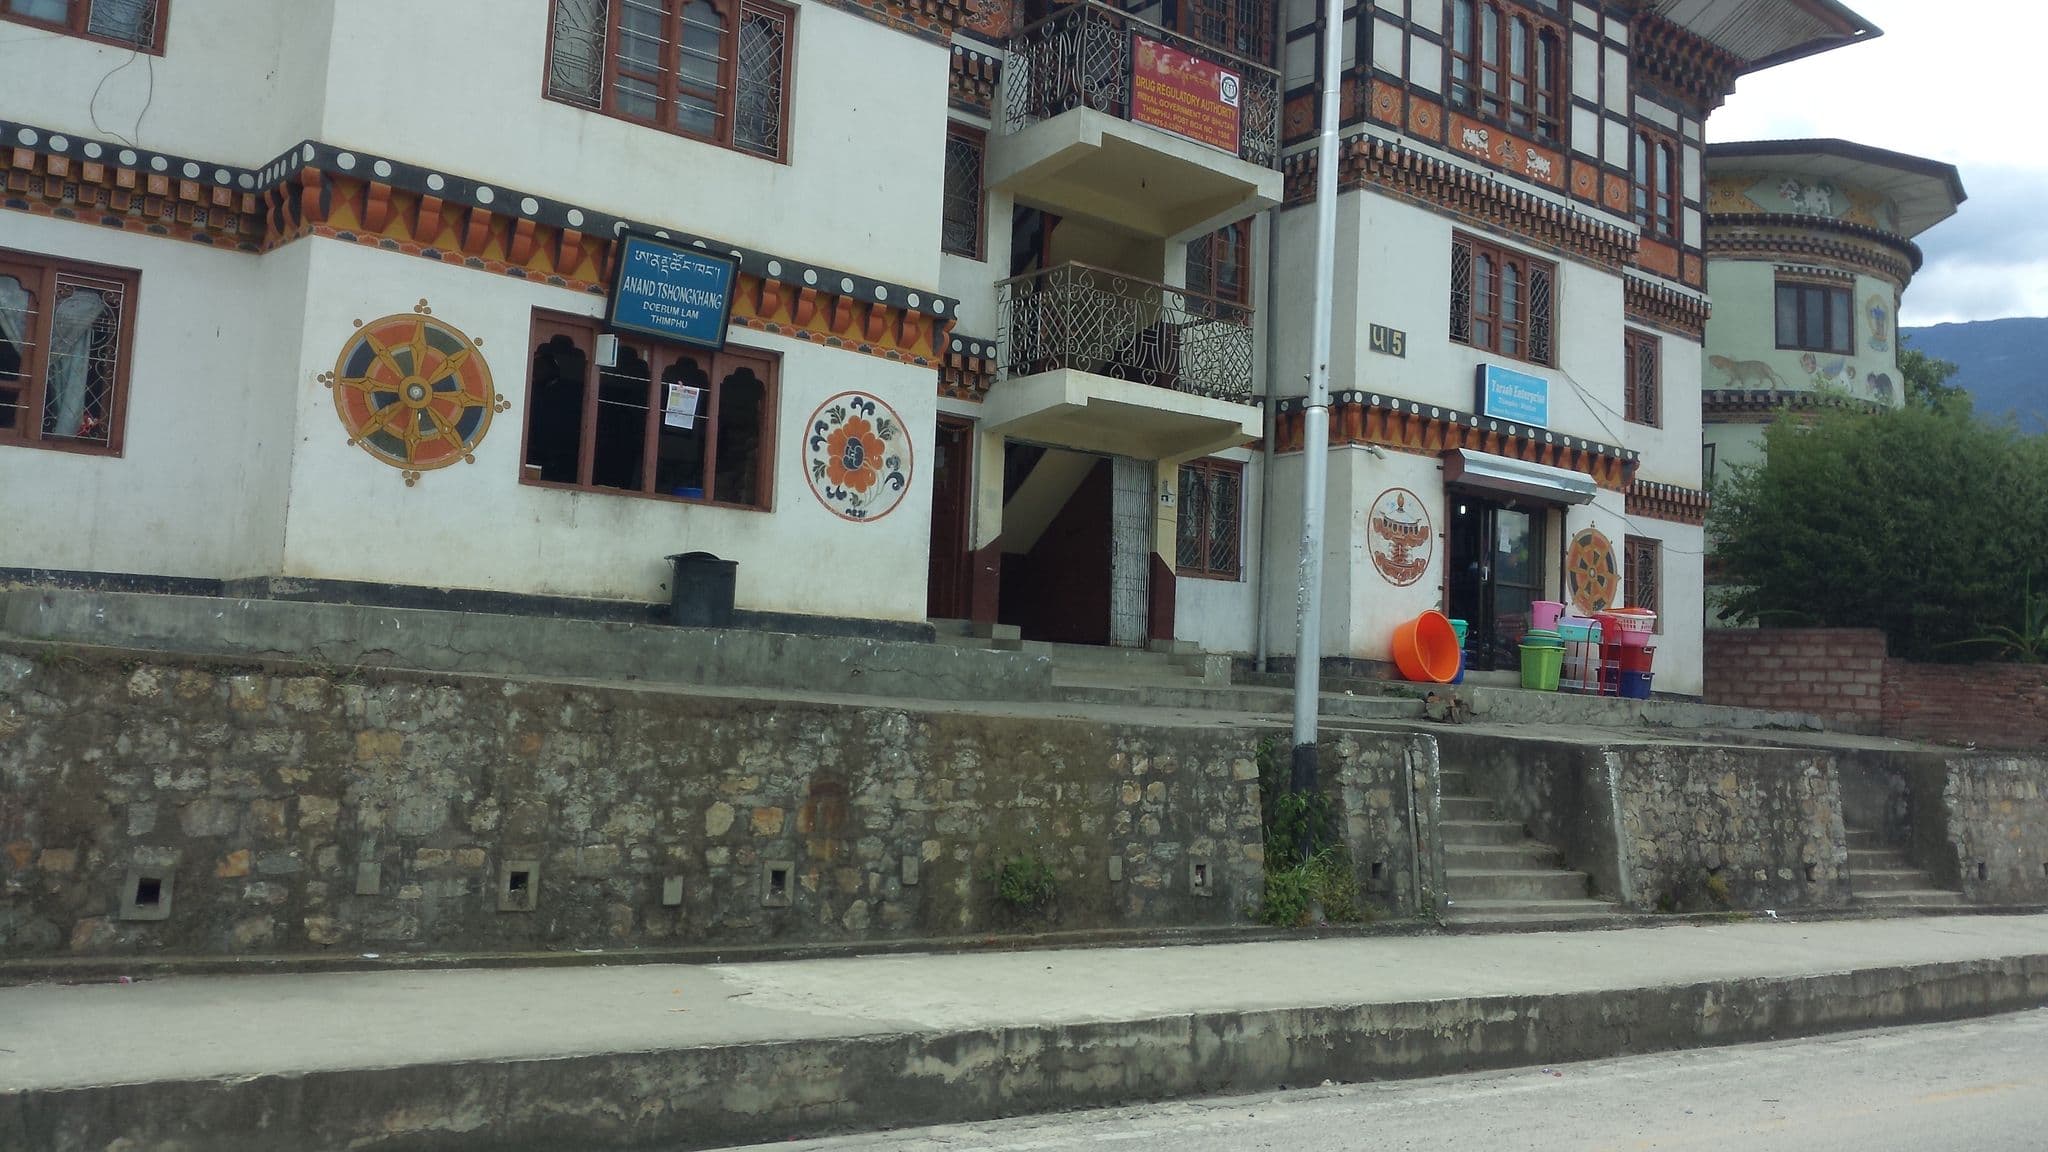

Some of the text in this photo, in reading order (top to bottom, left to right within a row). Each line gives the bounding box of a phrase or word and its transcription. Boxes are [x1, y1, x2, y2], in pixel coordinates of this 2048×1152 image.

[1135, 75, 1156, 92] DRUG
[1156, 82, 1200, 107] REGULATORY
[1200, 99, 1236, 119] AUTHORITY
[622, 275, 723, 310] ANAND TSHONGKHANG
[643, 301, 699, 320] DOEBUM LAM
[650, 314, 688, 329] THIMPHU
[1392, 331, 1402, 355] 5
